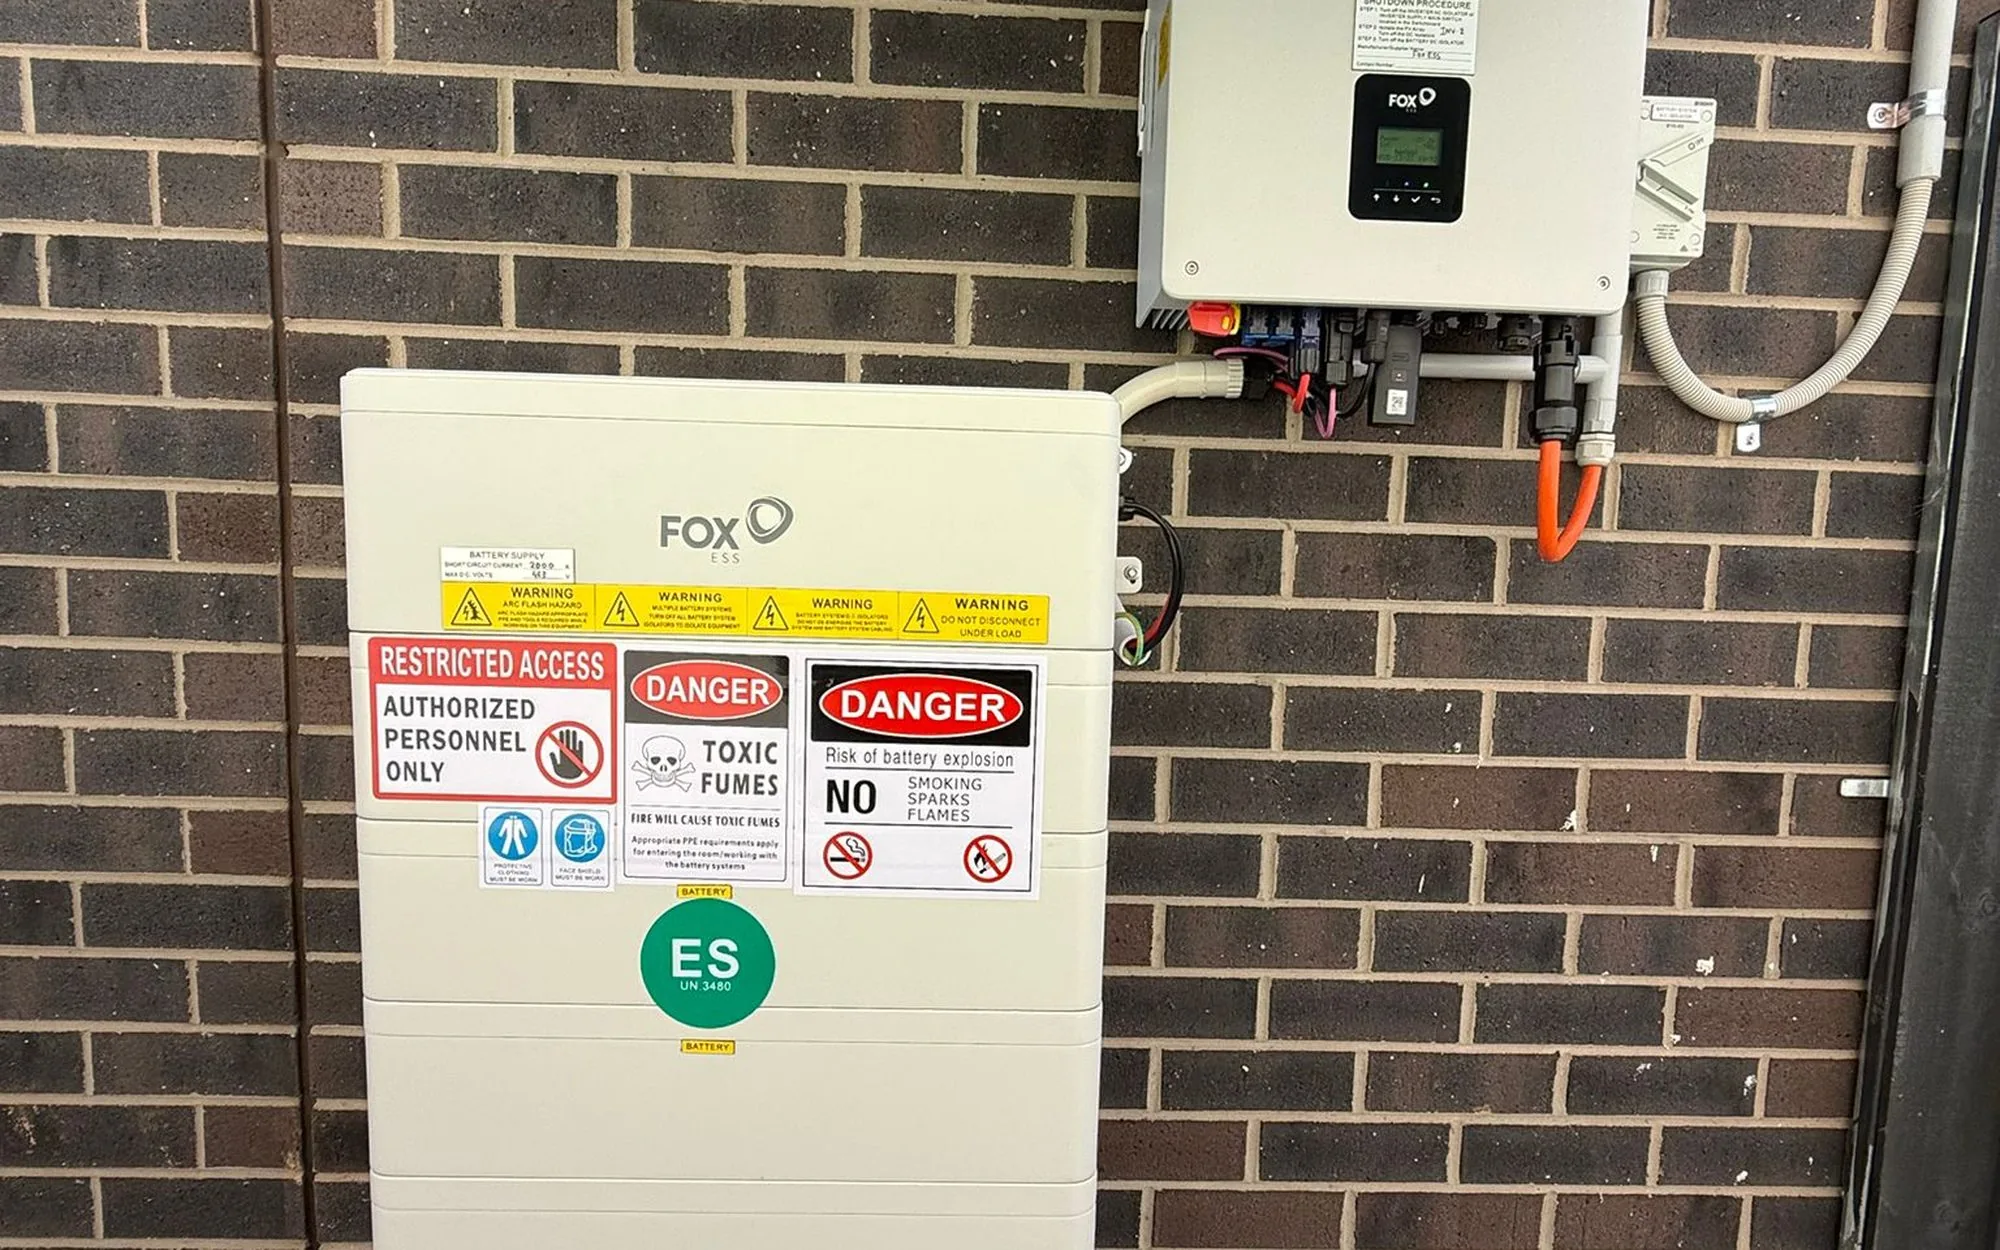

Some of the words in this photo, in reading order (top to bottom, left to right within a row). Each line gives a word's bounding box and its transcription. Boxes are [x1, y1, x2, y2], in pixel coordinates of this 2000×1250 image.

[1417, 0, 1471, 9] PROCEDURE
[1388, 94, 1418, 108] FOX
[660, 516, 740, 550] FOX
[470, 551, 509, 559] BATTERY
[511, 552, 545, 560] SUPPLY
[711, 552, 740, 564] ESS
[511, 587, 574, 599] WARNING
[659, 592, 722, 603] WARNING
[812, 598, 873, 610] WARNING
[955, 598, 1029, 611] WARNING
[941, 616, 955, 624] DO
[957, 616, 977, 624] NOT
[980, 616, 1041, 626] DISCONNECT
[960, 629, 993, 637] UNDER
[996, 630, 1022, 638] LOAD
[380, 646, 513, 678] RESTRICTED
[519, 649, 605, 681] ACCESS
[646, 675, 770, 706] DANGER
[383, 696, 536, 720] AUTHORIZED
[841, 690, 1006, 722] DANGER
[385, 728, 526, 752] PERSONNEL
[703, 740, 778, 765] TOXIC
[826, 747, 856, 763] Risk
[864, 749, 878, 764] of
[883, 749, 937, 769] battery
[944, 752, 1014, 768] explosion
[386, 760, 445, 782] ONLY
[702, 773, 778, 796] FUMES
[908, 776, 982, 791] SMOKING
[826, 779, 877, 814] NO
[908, 793, 970, 806] SPARKS
[631, 813, 652, 824] FIRE
[654, 814, 678, 825] WILL
[681, 815, 712, 826] CAUSE
[715, 816, 744, 826] TOXIC
[748, 816, 780, 828] FUMES
[908, 809, 970, 822] FLAMES
[631, 836, 681, 845] Appropriate
[683, 837, 698, 845] PPE
[700, 838, 755, 848] requirements
[756, 840, 779, 849] apply
[633, 848, 645, 856] for
[647, 849, 681, 858] entering
[698, 851, 757, 860] room/working
[680, 861, 710, 871] battery
[712, 863, 746, 871] systems
[682, 888, 727, 896] BATTERY
[672, 938, 740, 979] ES
[686, 1042, 730, 1050] BATTERY
